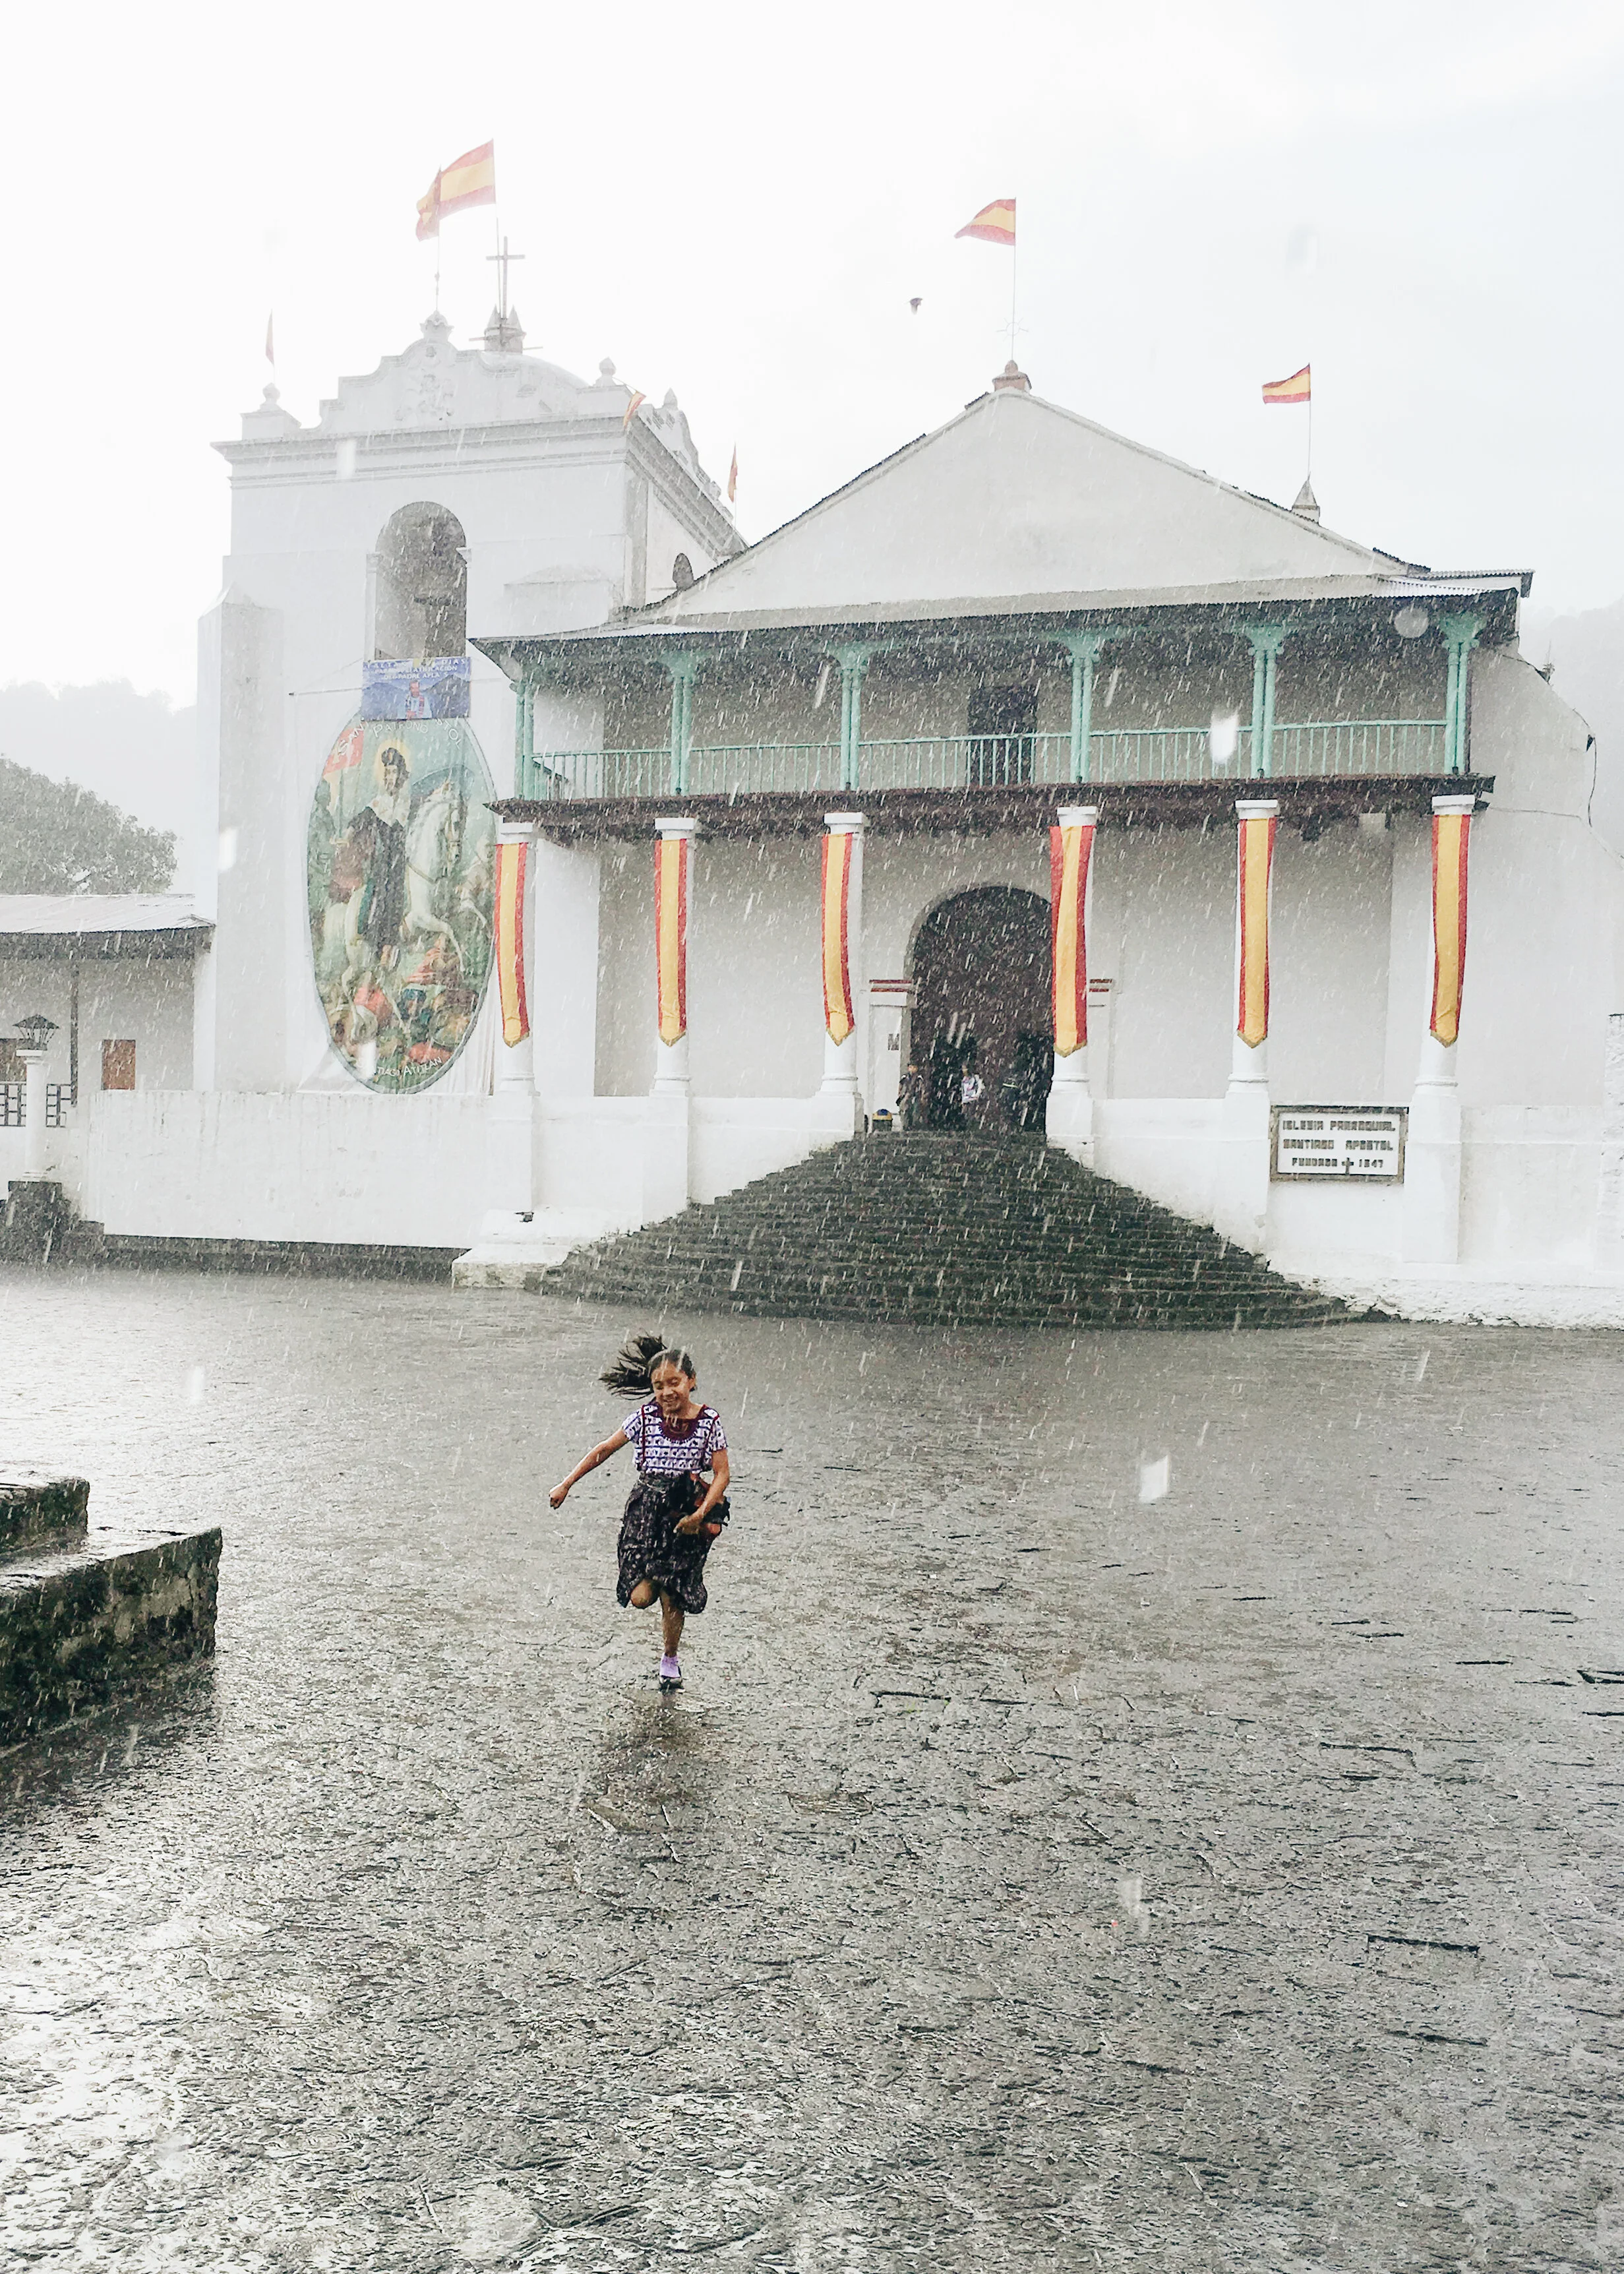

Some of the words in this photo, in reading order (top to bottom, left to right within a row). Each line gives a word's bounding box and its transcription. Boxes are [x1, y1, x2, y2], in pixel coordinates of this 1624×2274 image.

[1282, 1120, 1323, 1130] IGLESIA
[1283, 1138, 1335, 1150] SANTIAGO
[1345, 1140, 1393, 1151] APOSTOL
